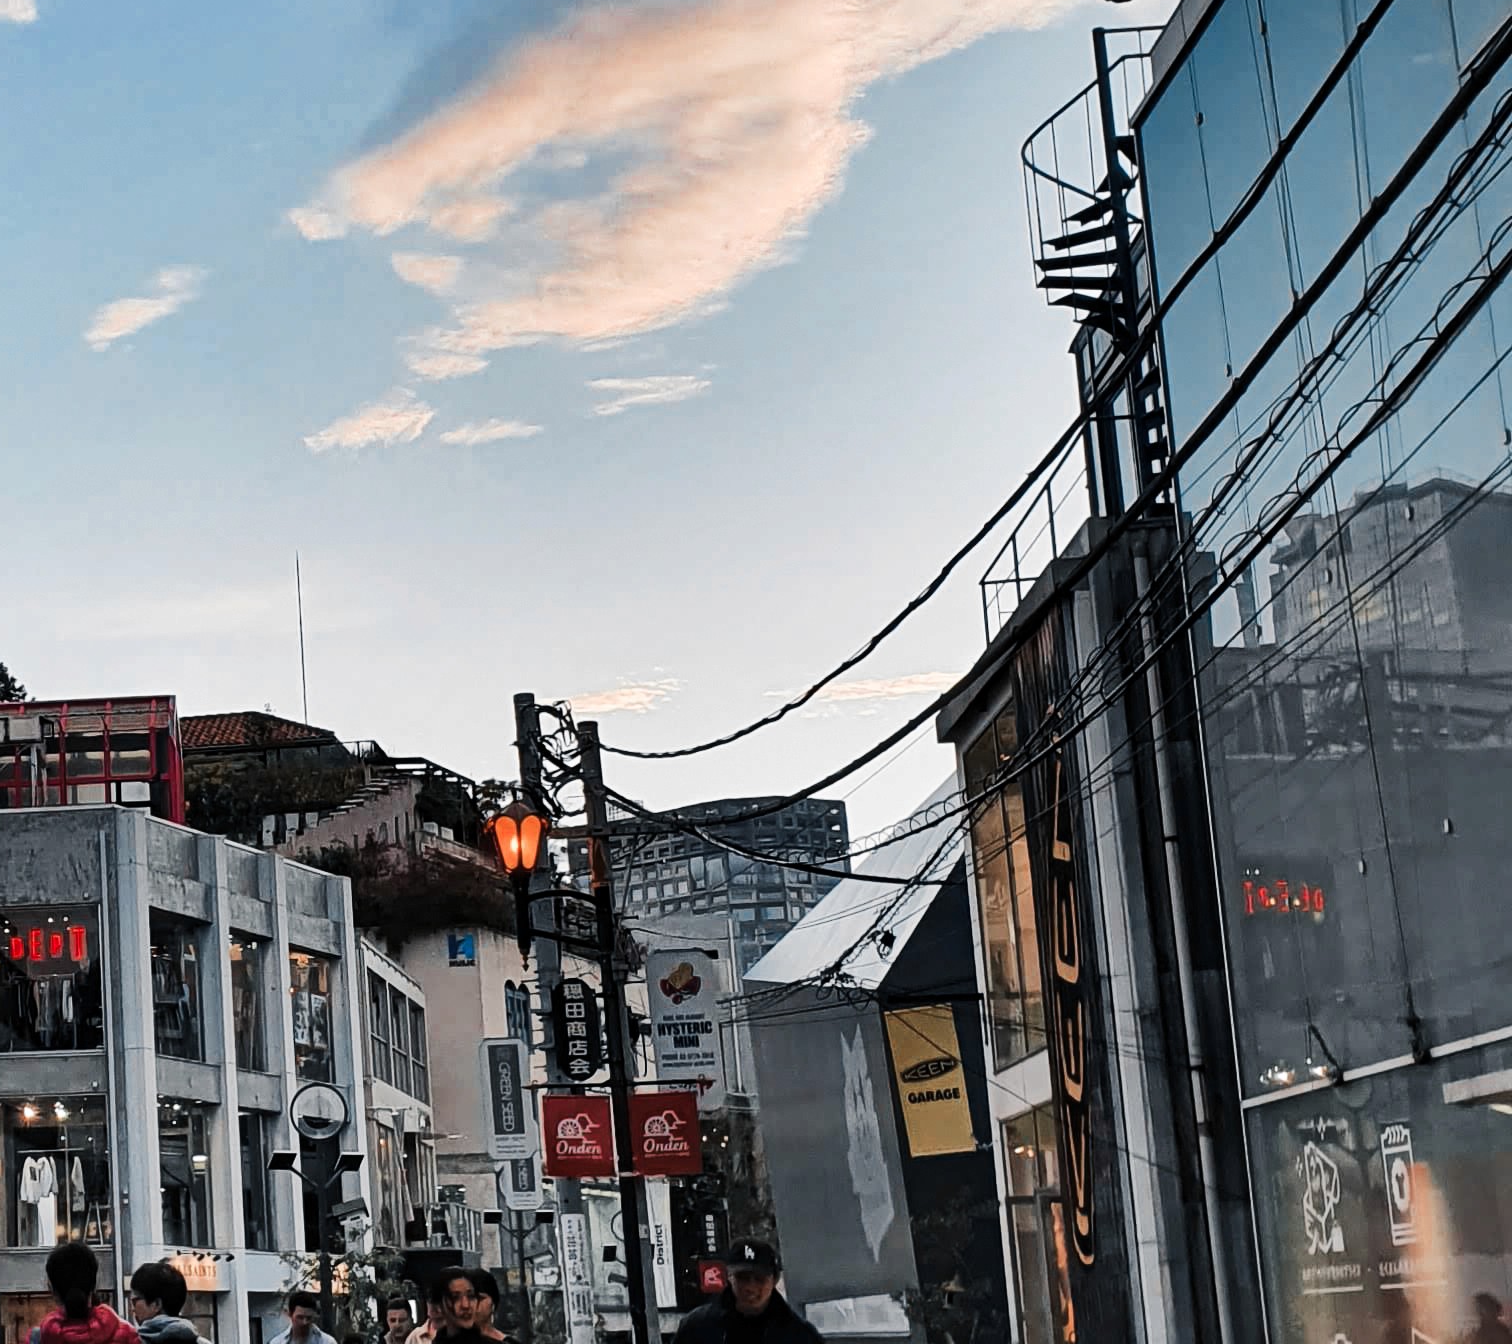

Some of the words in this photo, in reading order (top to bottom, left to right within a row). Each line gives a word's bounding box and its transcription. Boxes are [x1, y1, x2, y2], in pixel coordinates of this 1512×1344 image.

[10, 925, 87, 961] DEPT
[657, 1021, 713, 1036] HYSTERIC
[904, 1059, 955, 1080] KEEN
[499, 1062, 512, 1101] GREEN
[908, 1088, 961, 1104] GARAGE
[501, 1102, 514, 1131] SEED
[556, 1140, 602, 1155] Onden
[643, 1138, 690, 1154] Onden
